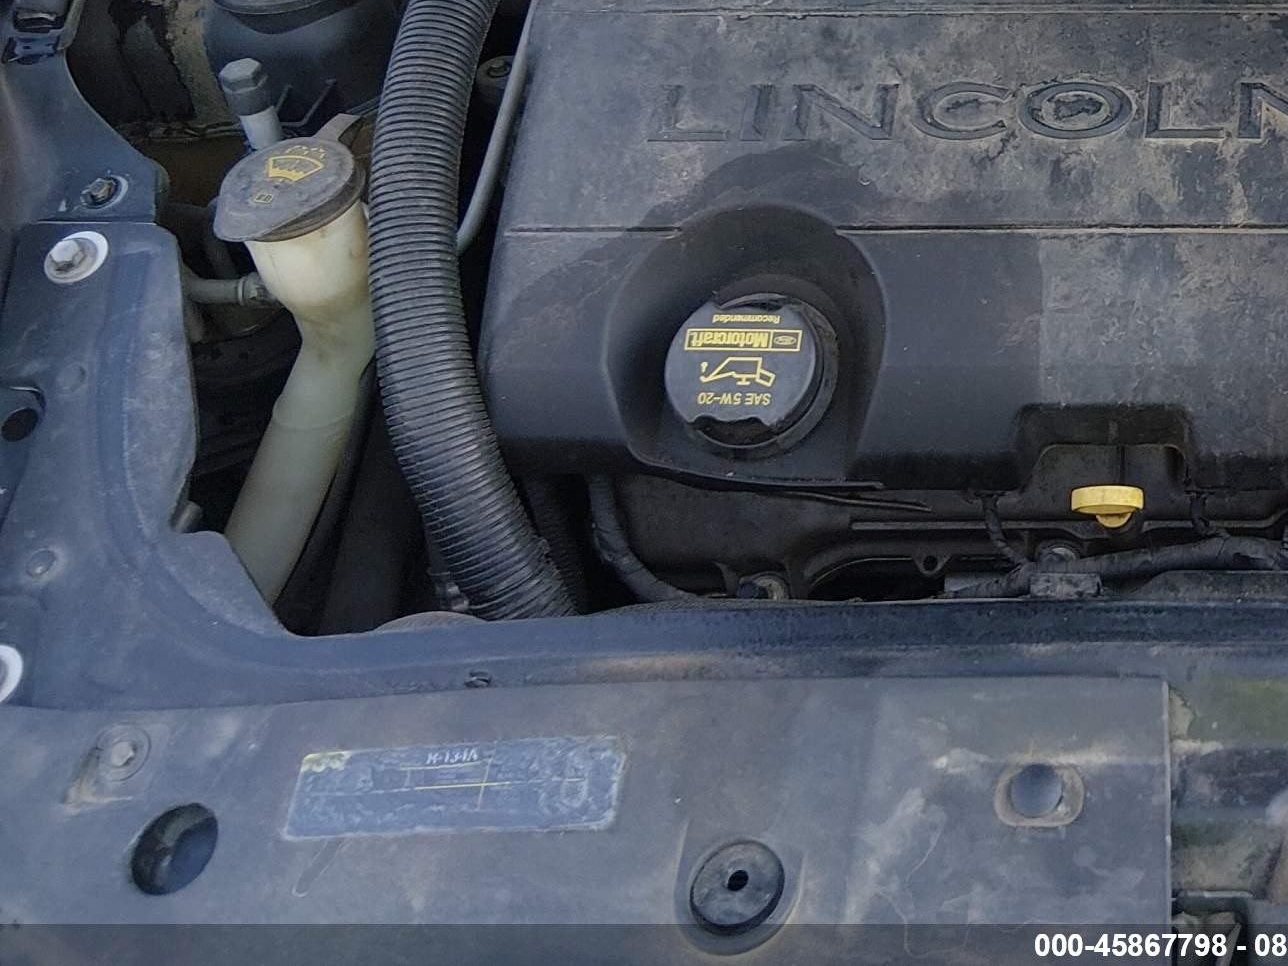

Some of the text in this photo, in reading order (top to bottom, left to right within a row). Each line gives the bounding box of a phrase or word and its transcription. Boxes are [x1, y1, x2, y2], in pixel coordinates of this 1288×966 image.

[713, 314, 780, 324] Recommended
[689, 331, 769, 348] Motorcraft
[698, 392, 771, 405] SAE 5W-20
